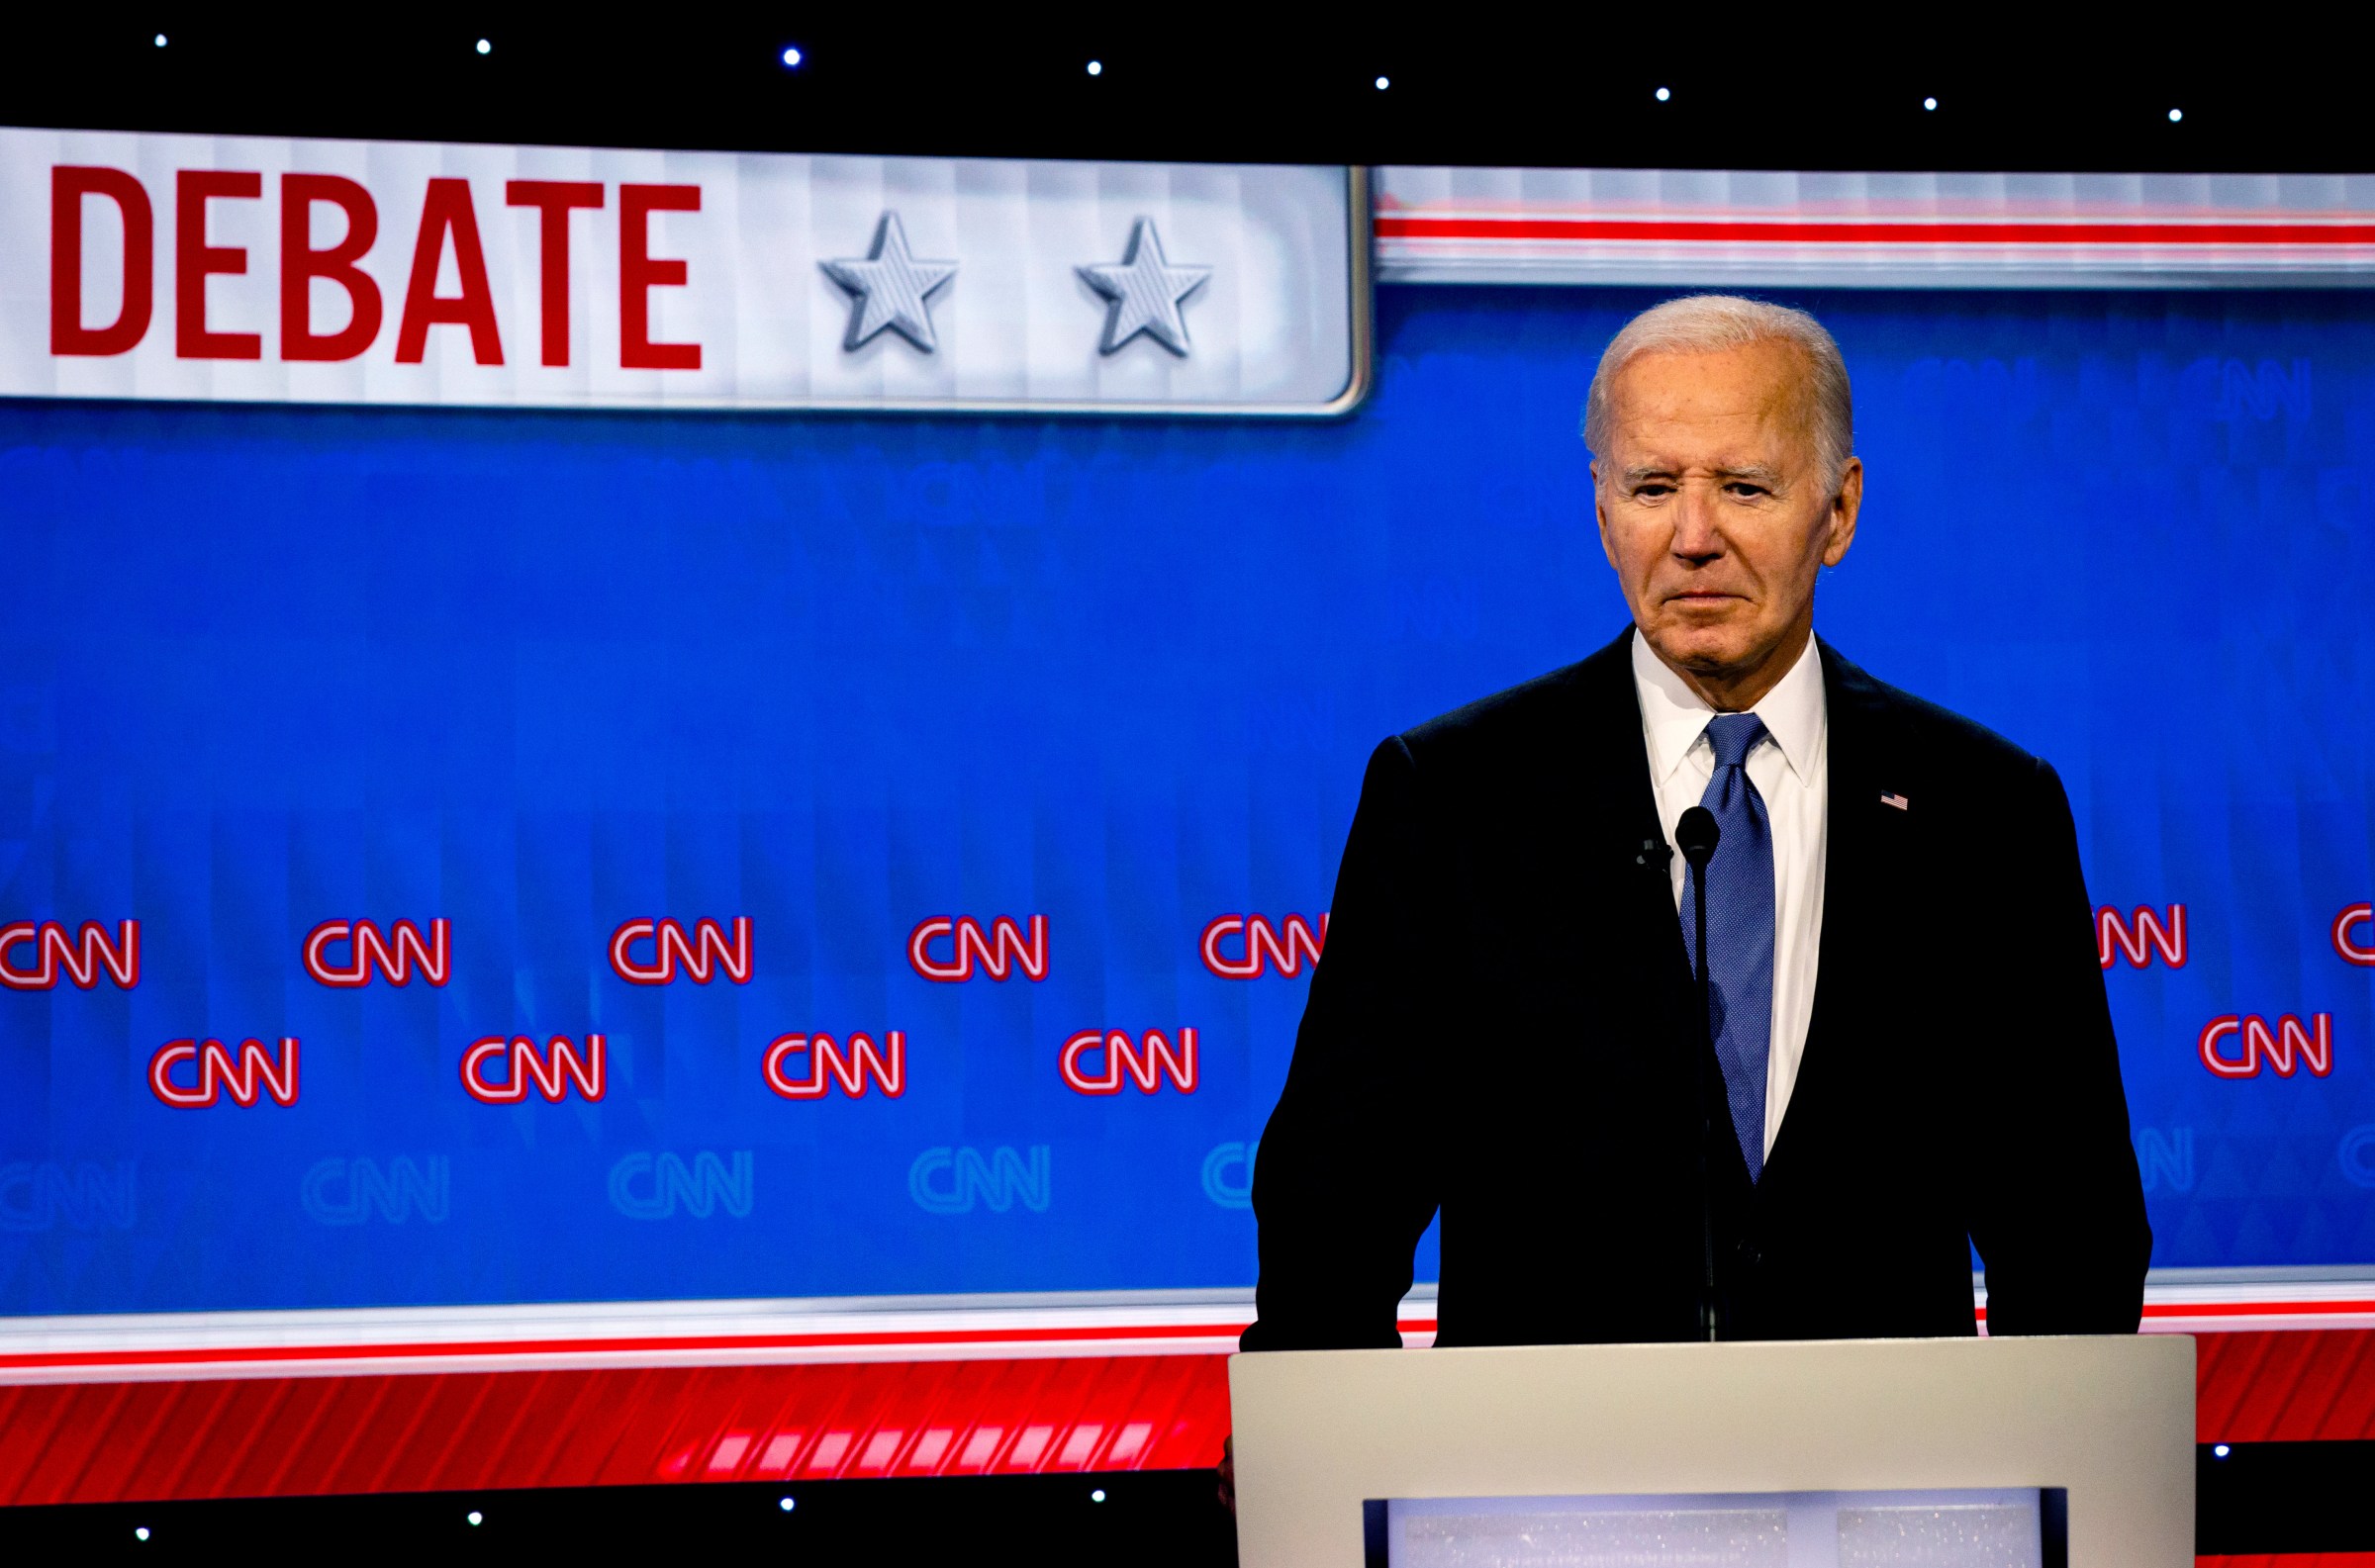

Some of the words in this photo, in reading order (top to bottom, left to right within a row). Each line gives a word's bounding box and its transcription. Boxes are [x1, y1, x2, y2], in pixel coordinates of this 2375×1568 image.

[50, 164, 702, 370] DEBATE
[0, 919, 140, 988] CNN
[304, 918, 451, 987] CNN
[609, 916, 753, 984] CNN
[908, 914, 1049, 982] CNN
[2090, 904, 2187, 969] NN
[148, 1038, 300, 1108] CNN
[459, 1034, 607, 1104] CNN
[762, 1031, 906, 1100] CNN
[1058, 1027, 1199, 1095] CNN
[2198, 1013, 2332, 1078] CNN
[0, 1160, 137, 1231] CNN
[301, 1154, 450, 1226] CNN
[608, 1151, 753, 1220] CNN
[908, 1145, 1051, 1215] CNN
